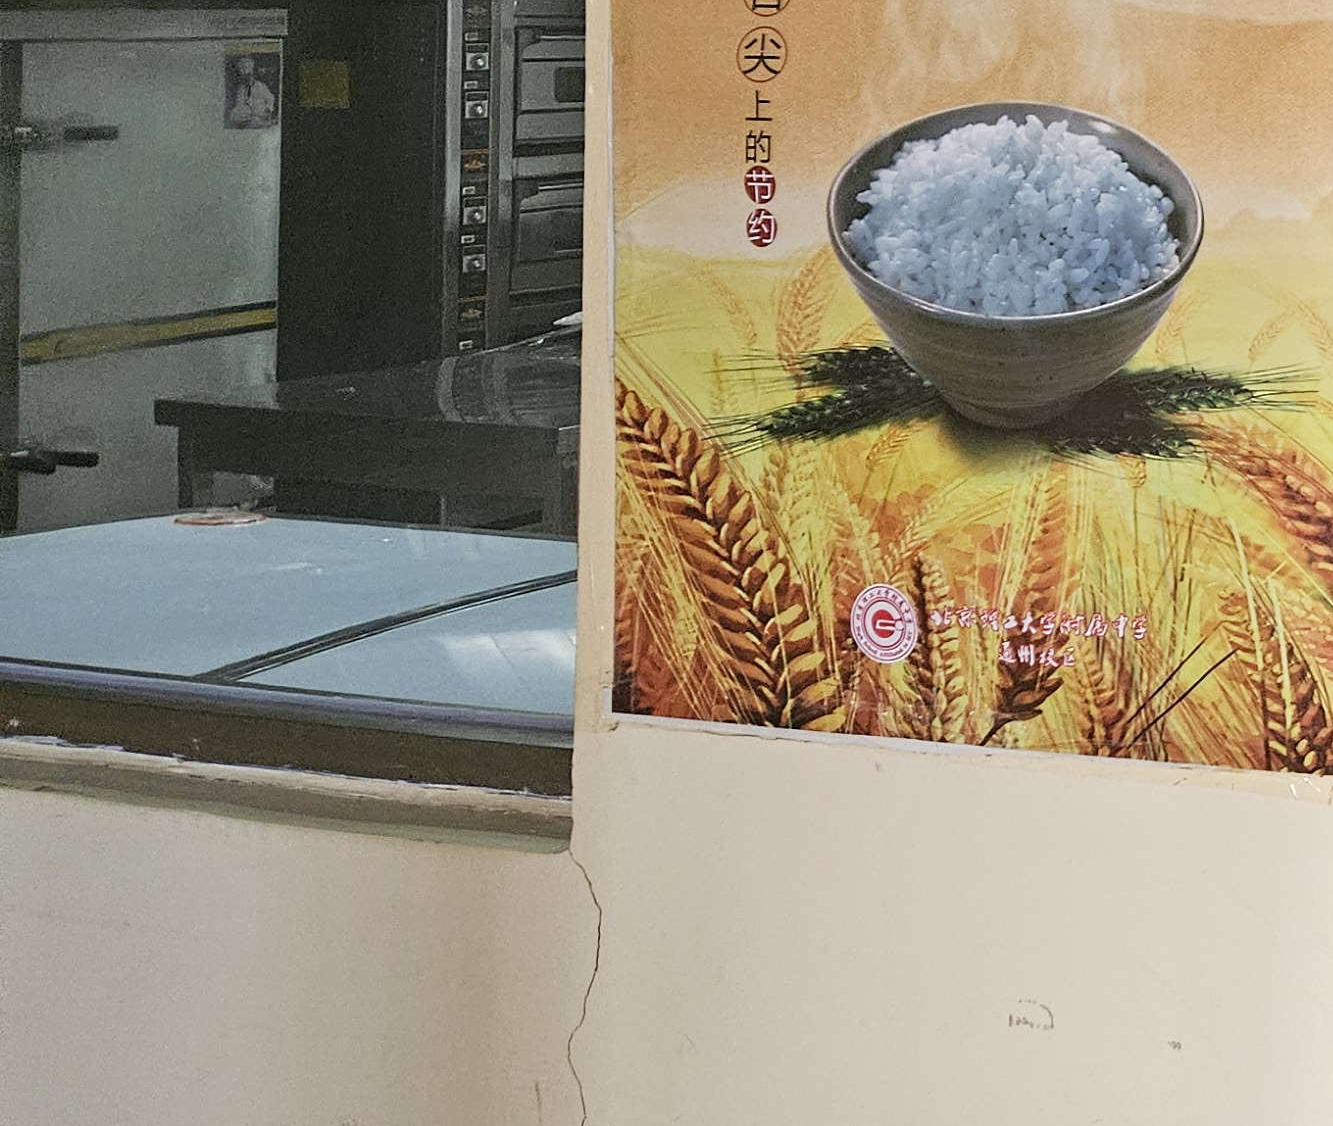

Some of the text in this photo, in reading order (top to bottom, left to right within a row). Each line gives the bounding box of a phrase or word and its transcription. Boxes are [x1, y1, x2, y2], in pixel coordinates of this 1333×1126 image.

[929, 605, 1149, 640] 北京理工大学附属中学
[997, 641, 1077, 667] 通州校区
